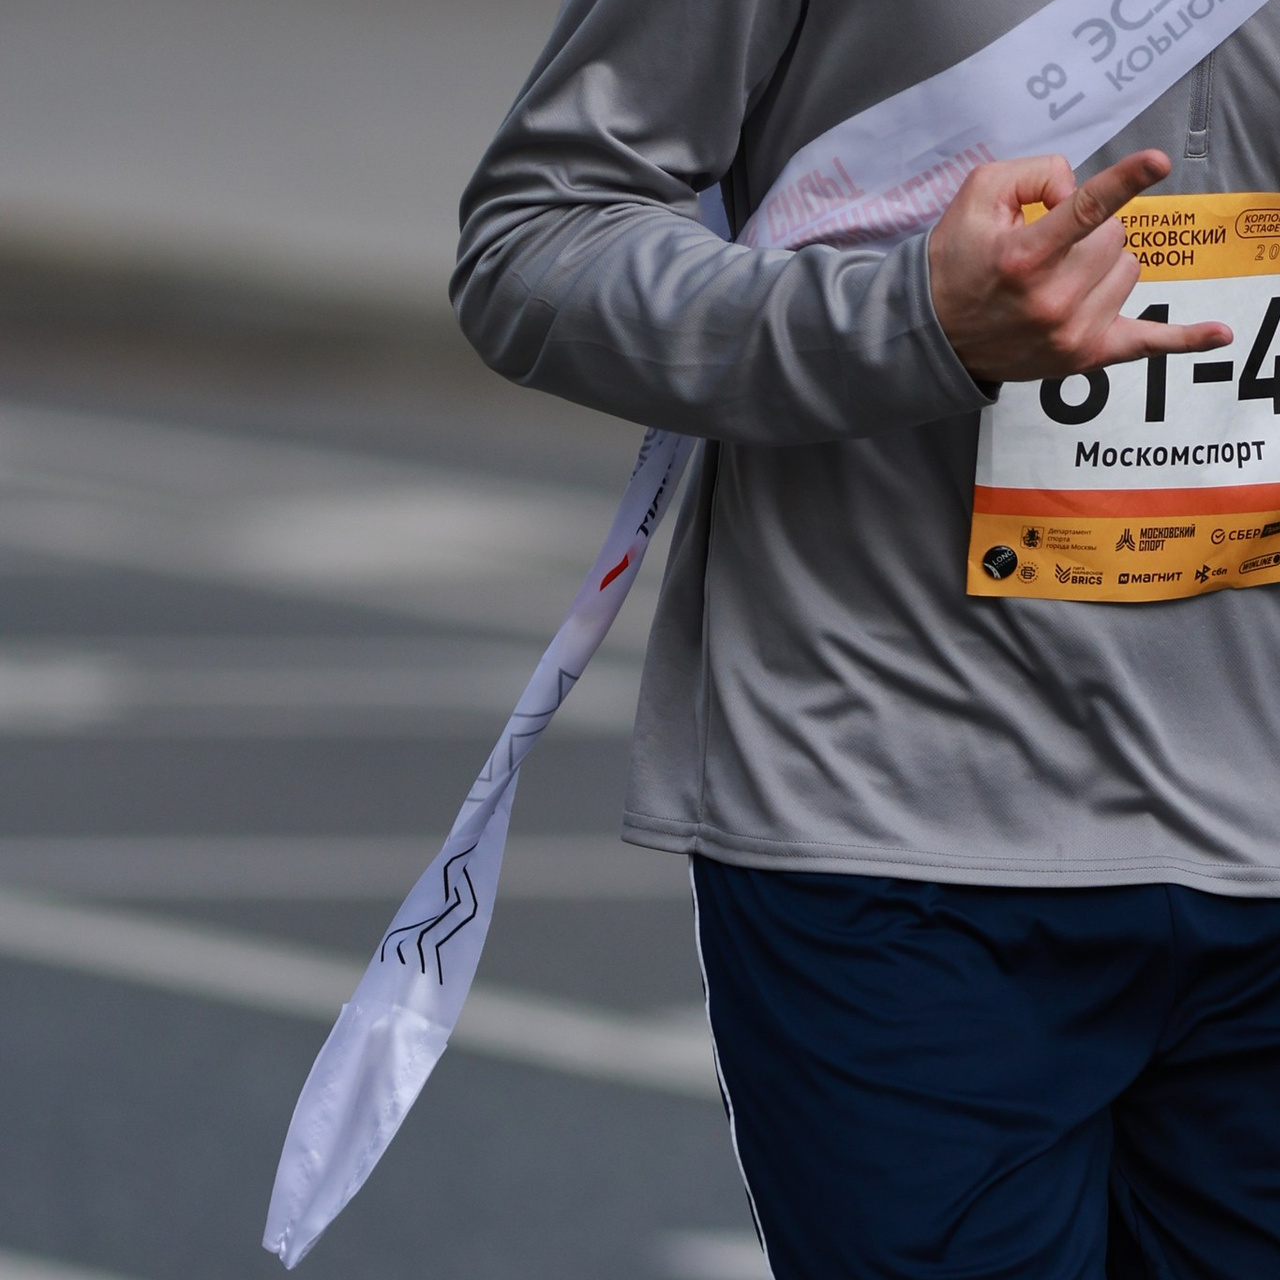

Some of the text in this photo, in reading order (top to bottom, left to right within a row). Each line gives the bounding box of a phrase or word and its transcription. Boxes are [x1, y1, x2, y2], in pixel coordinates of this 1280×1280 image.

[1119, 210, 1195, 228] ЕРПРАЙМ
[1122, 225, 1226, 249] СКОВСКИЙ
[1132, 249, 1194, 267] АФОН
[1075, 440, 1265, 468] Москомспорт
[1140, 523, 1196, 539] МОСКОВСКИЙ
[1228, 528, 1261, 540] СБЕР
[1139, 540, 1165, 552] СПОРТ
[1242, 556, 1273, 571] WINLINE
[1071, 575, 1103, 585] BRICS
